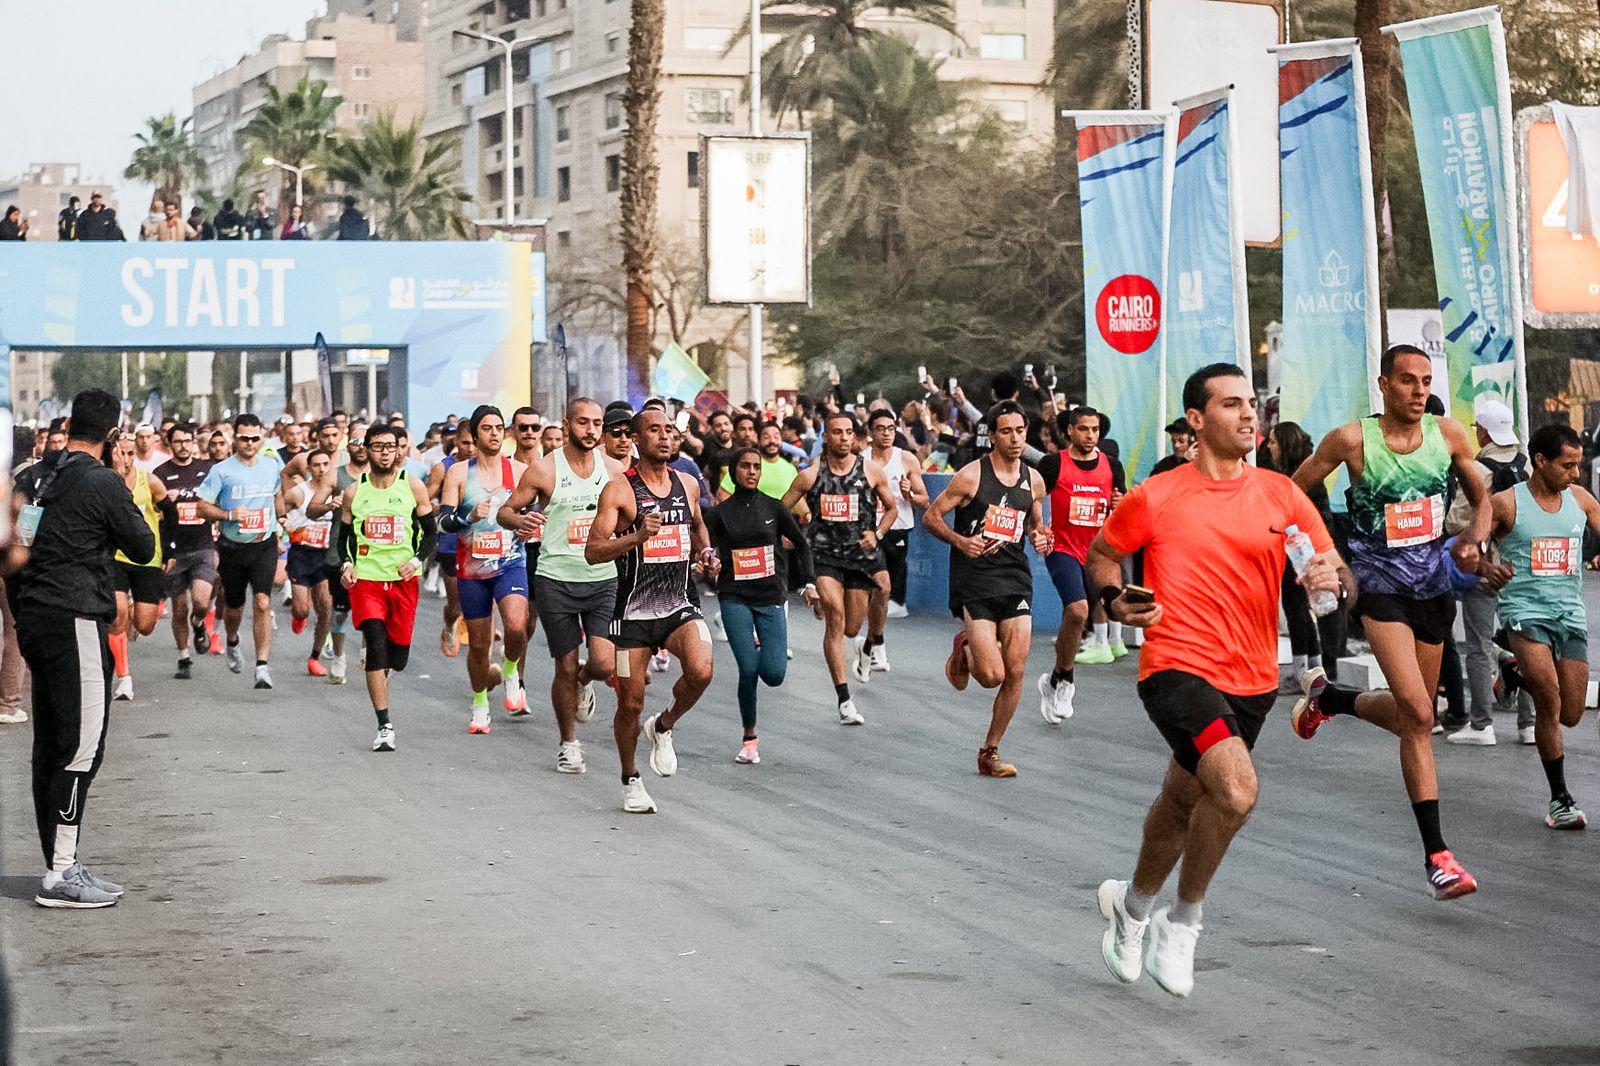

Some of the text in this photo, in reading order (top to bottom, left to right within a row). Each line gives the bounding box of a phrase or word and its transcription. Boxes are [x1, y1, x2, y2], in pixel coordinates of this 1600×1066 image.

[121, 257, 296, 327] START
[1108, 295, 1153, 318] CAIRO
[1109, 318, 1153, 332] RUNNERS
[825, 502, 848, 512] 11103
[663, 510, 684, 523] YPT
[1397, 516, 1423, 529] HAMDI
[367, 523, 392, 534] 11153
[573, 526, 591, 538] 110
[646, 538, 679, 549] MARZOUK
[1537, 549, 1566, 562] 11092
